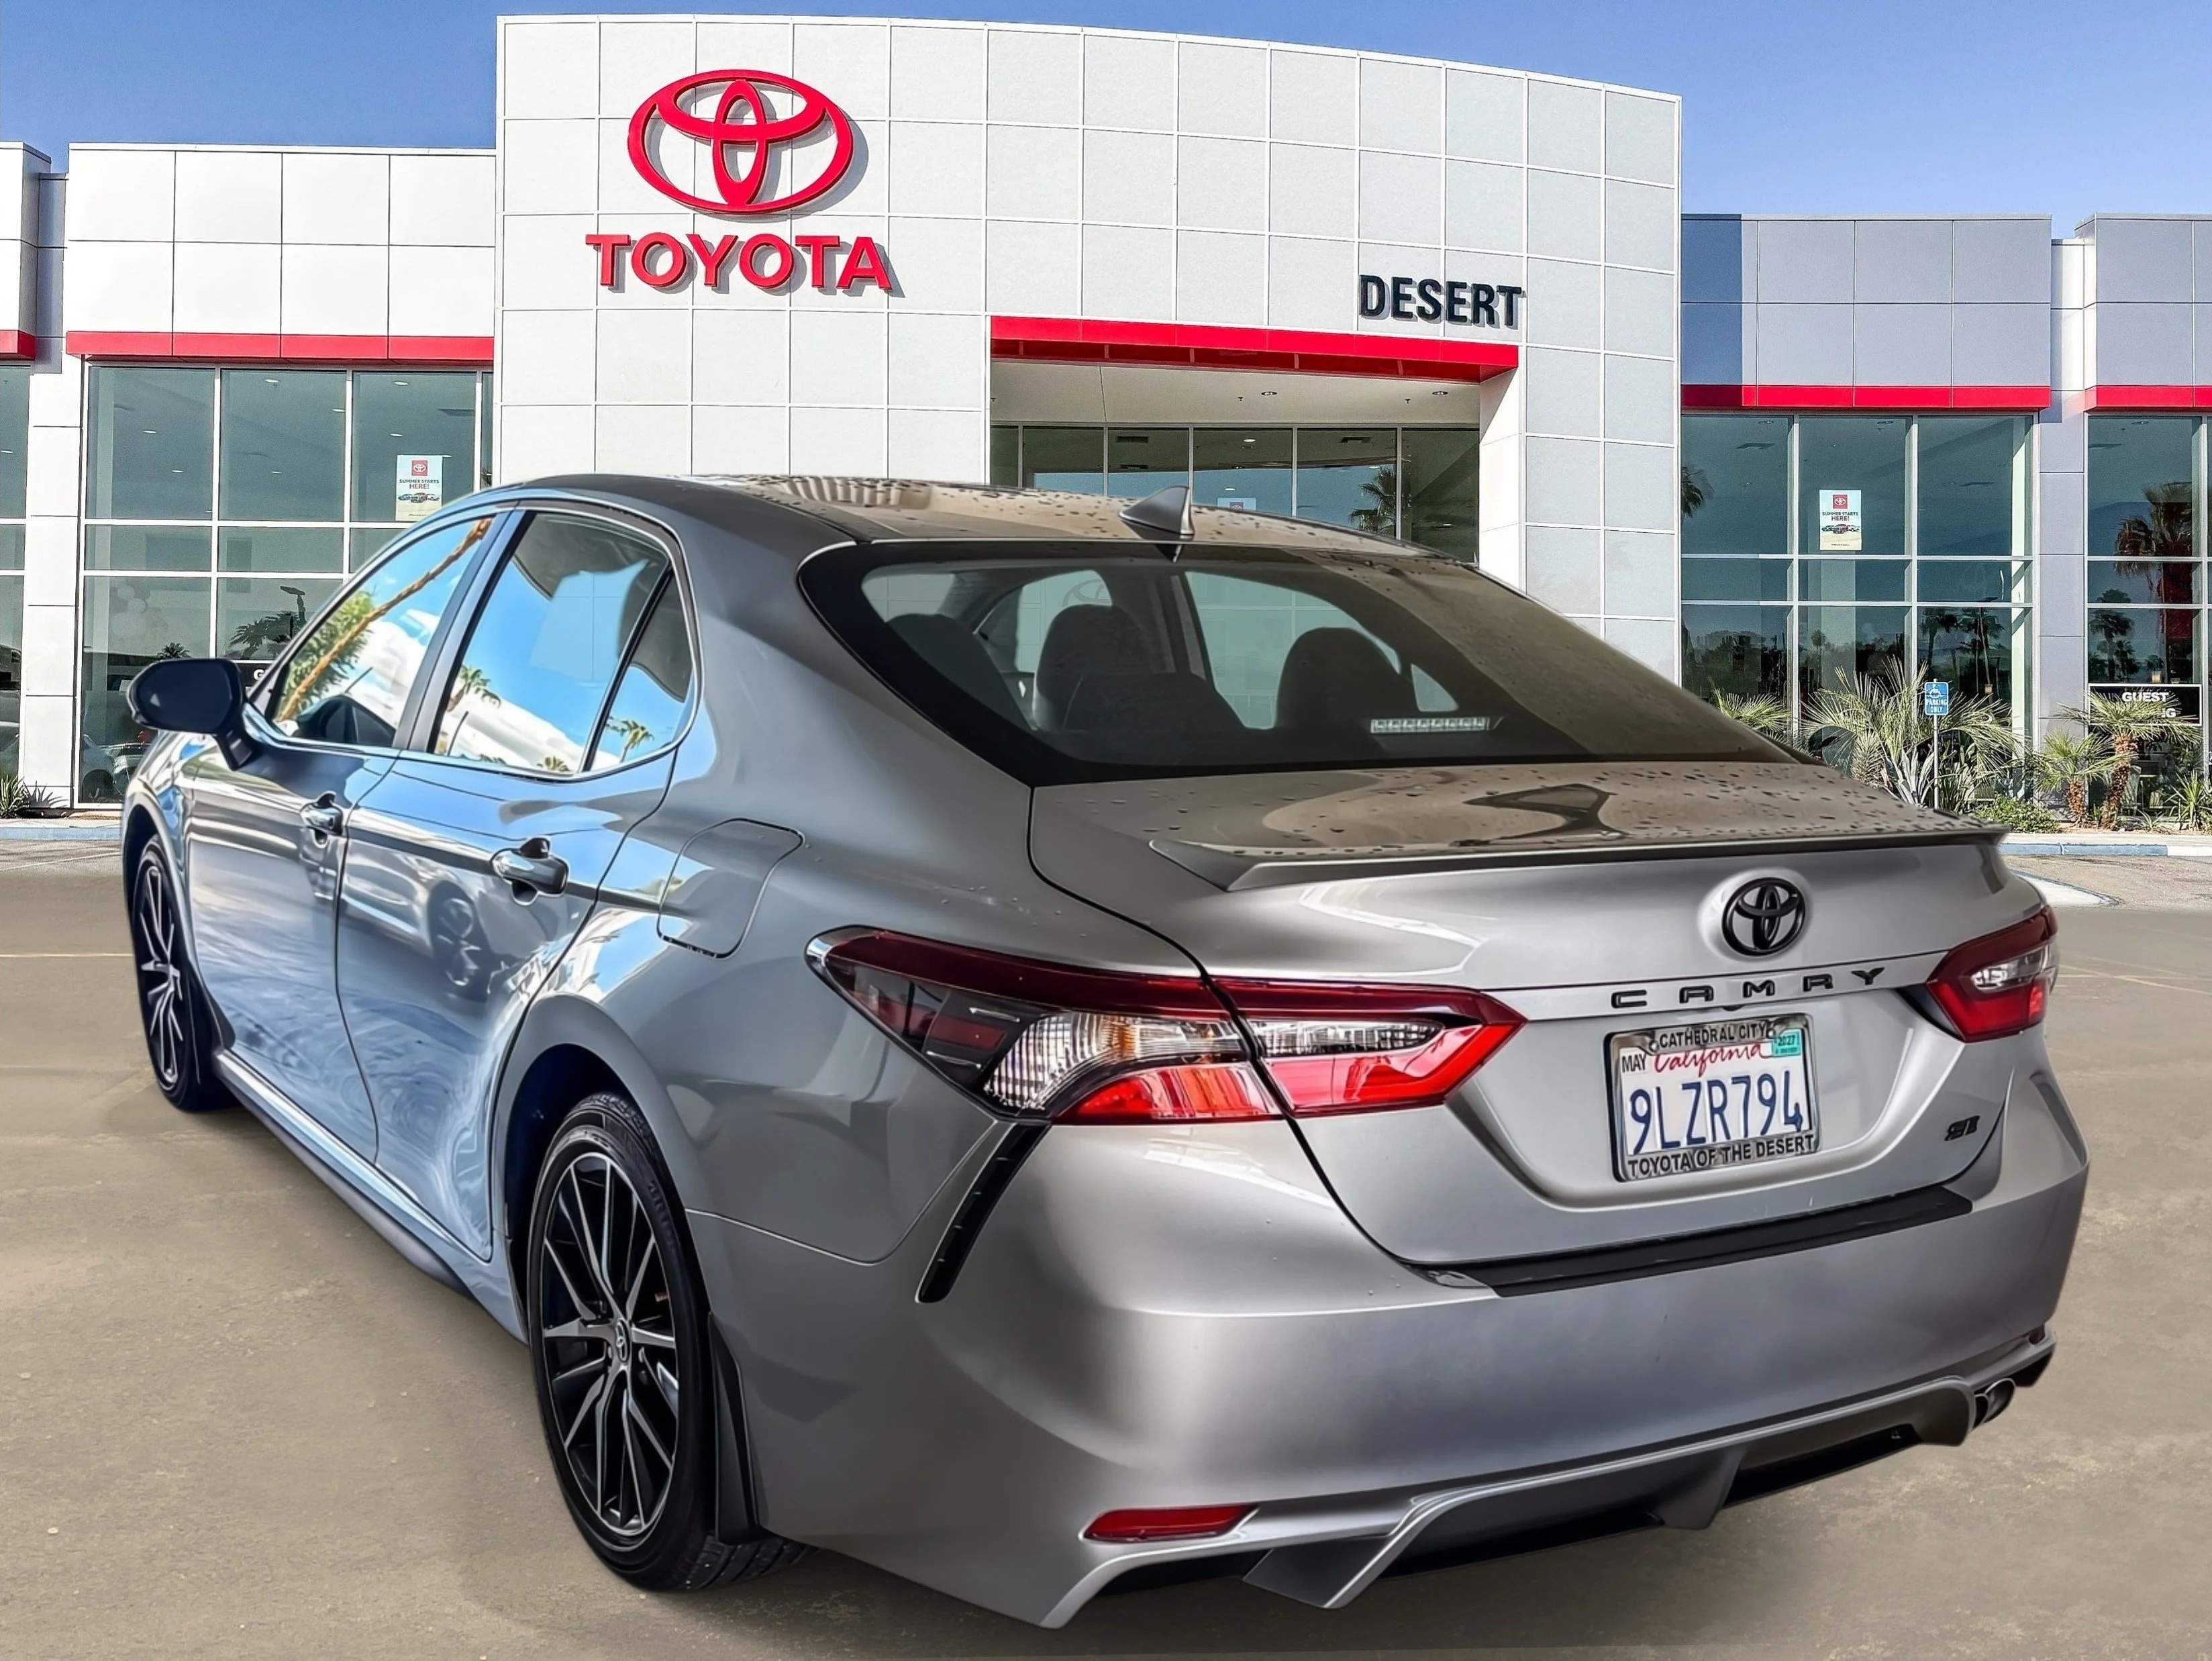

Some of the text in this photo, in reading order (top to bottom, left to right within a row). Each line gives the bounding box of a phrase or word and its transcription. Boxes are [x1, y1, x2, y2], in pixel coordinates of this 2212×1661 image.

[585, 232, 893, 291] TOYOTA
[1358, 274, 1522, 327] DESERT
[2121, 691, 2169, 703] GUEST
[1611, 967, 1885, 1009] CAMRY
[1659, 1023, 1767, 1048] CATHEDRAL CITY
[1621, 1053, 1647, 1073] MAY
[1654, 1042, 1772, 1078] California
[1629, 1070, 1804, 1156] 9LZR794
[1628, 1134, 1815, 1176] TOYOTA OF THE DESERT
